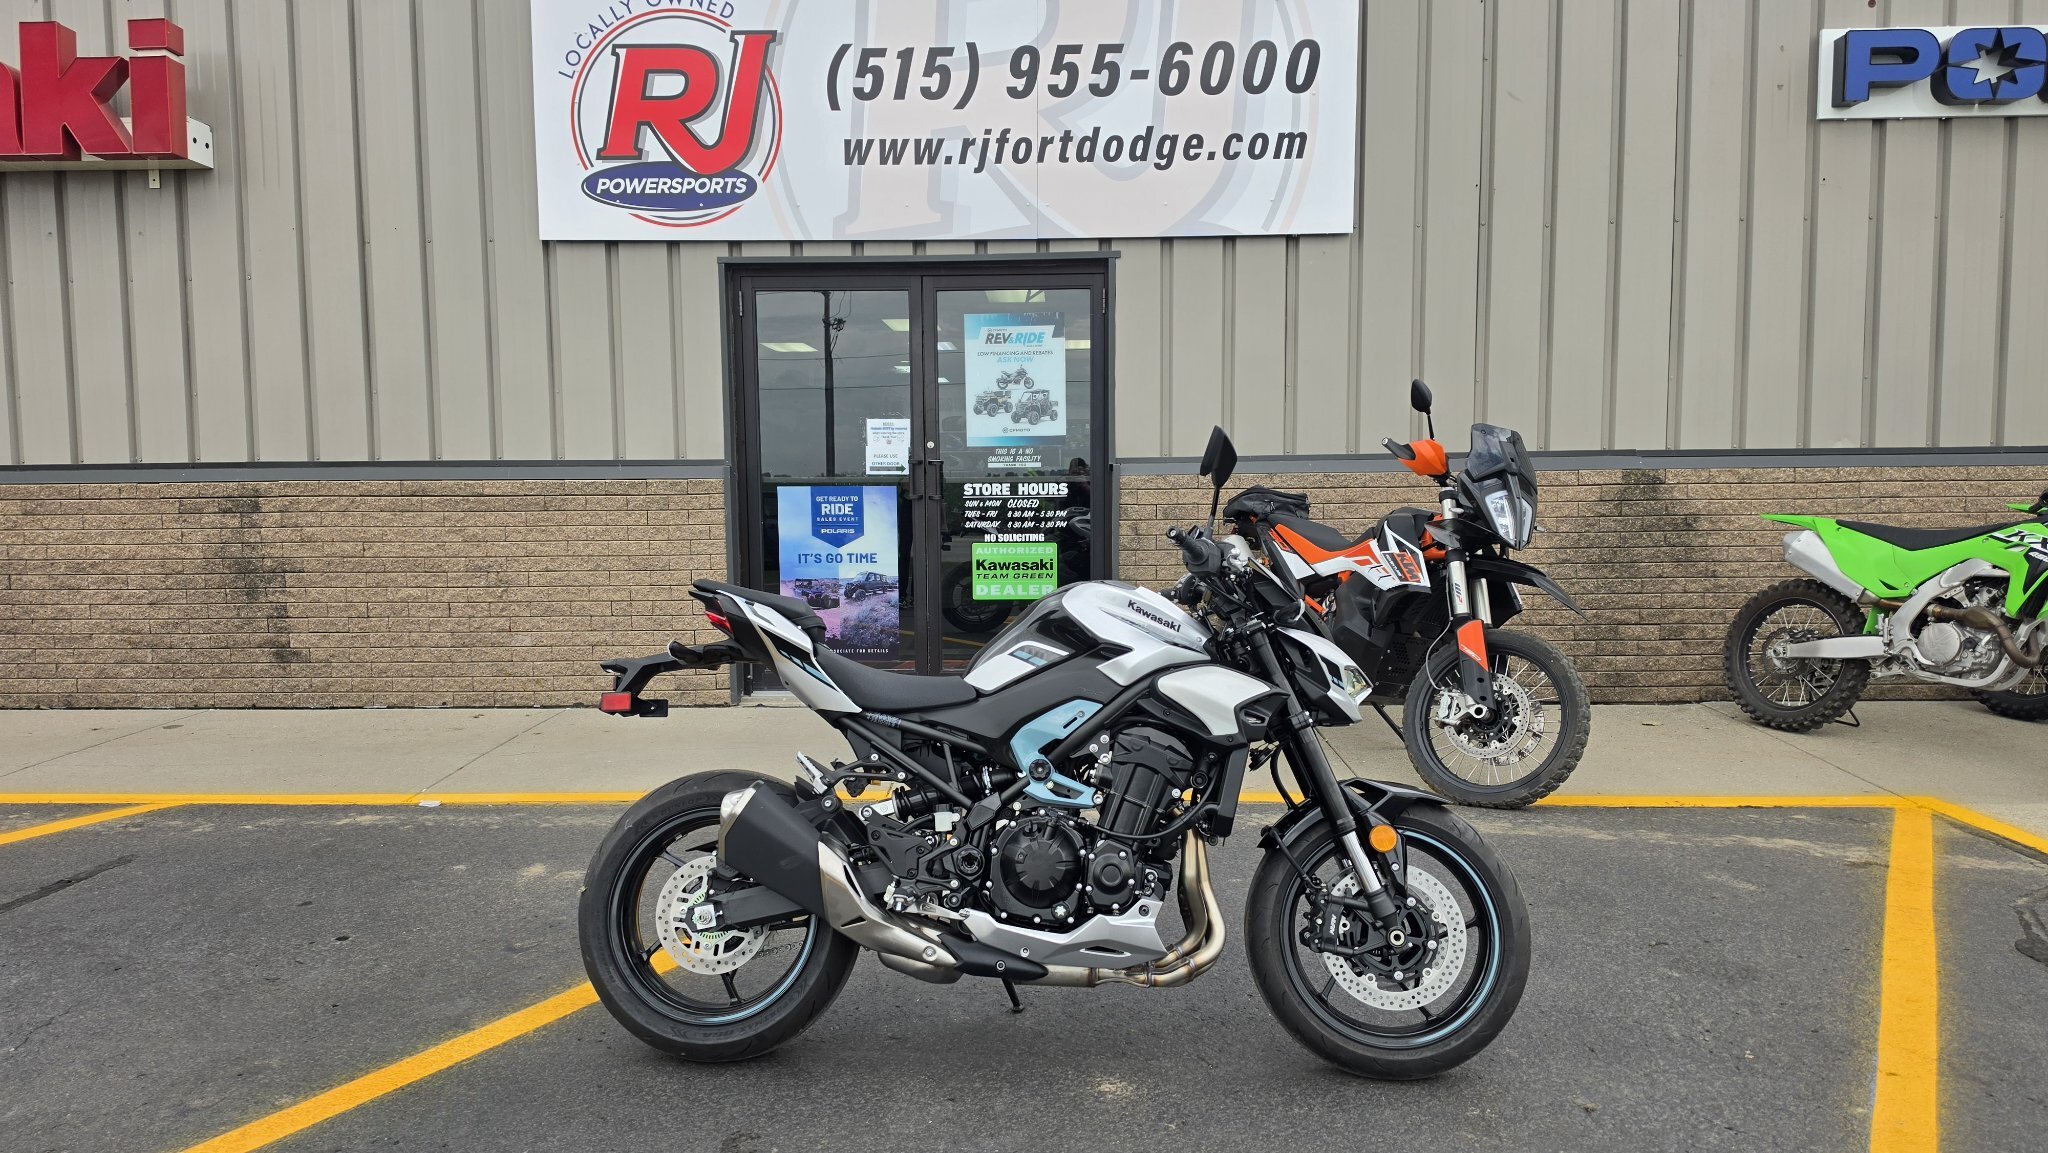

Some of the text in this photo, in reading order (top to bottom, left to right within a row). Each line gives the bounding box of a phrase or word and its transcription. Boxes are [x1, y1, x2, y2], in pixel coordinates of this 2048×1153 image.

[558, 0, 633, 79] LOCALLY
[826, 39, 1321, 110] (515) 955-6000
[0, 18, 188, 160] ki
[596, 30, 780, 176] RJ
[844, 126, 1307, 173] www.rjfortdodge.com
[597, 178, 748, 194] POWERSPORTS
[963, 482, 1069, 495] STORE HOURS
[821, 503, 854, 515] RIDE
[1007, 499, 1039, 508] CLOSED
[984, 533, 1044, 542] NO SOLICITING
[798, 553, 877, 564] IT'S GO TIME
[976, 559, 1054, 570] Kawasaki
[976, 585, 1054, 596] DEALER
[1127, 600, 1181, 633] Kawasaki
